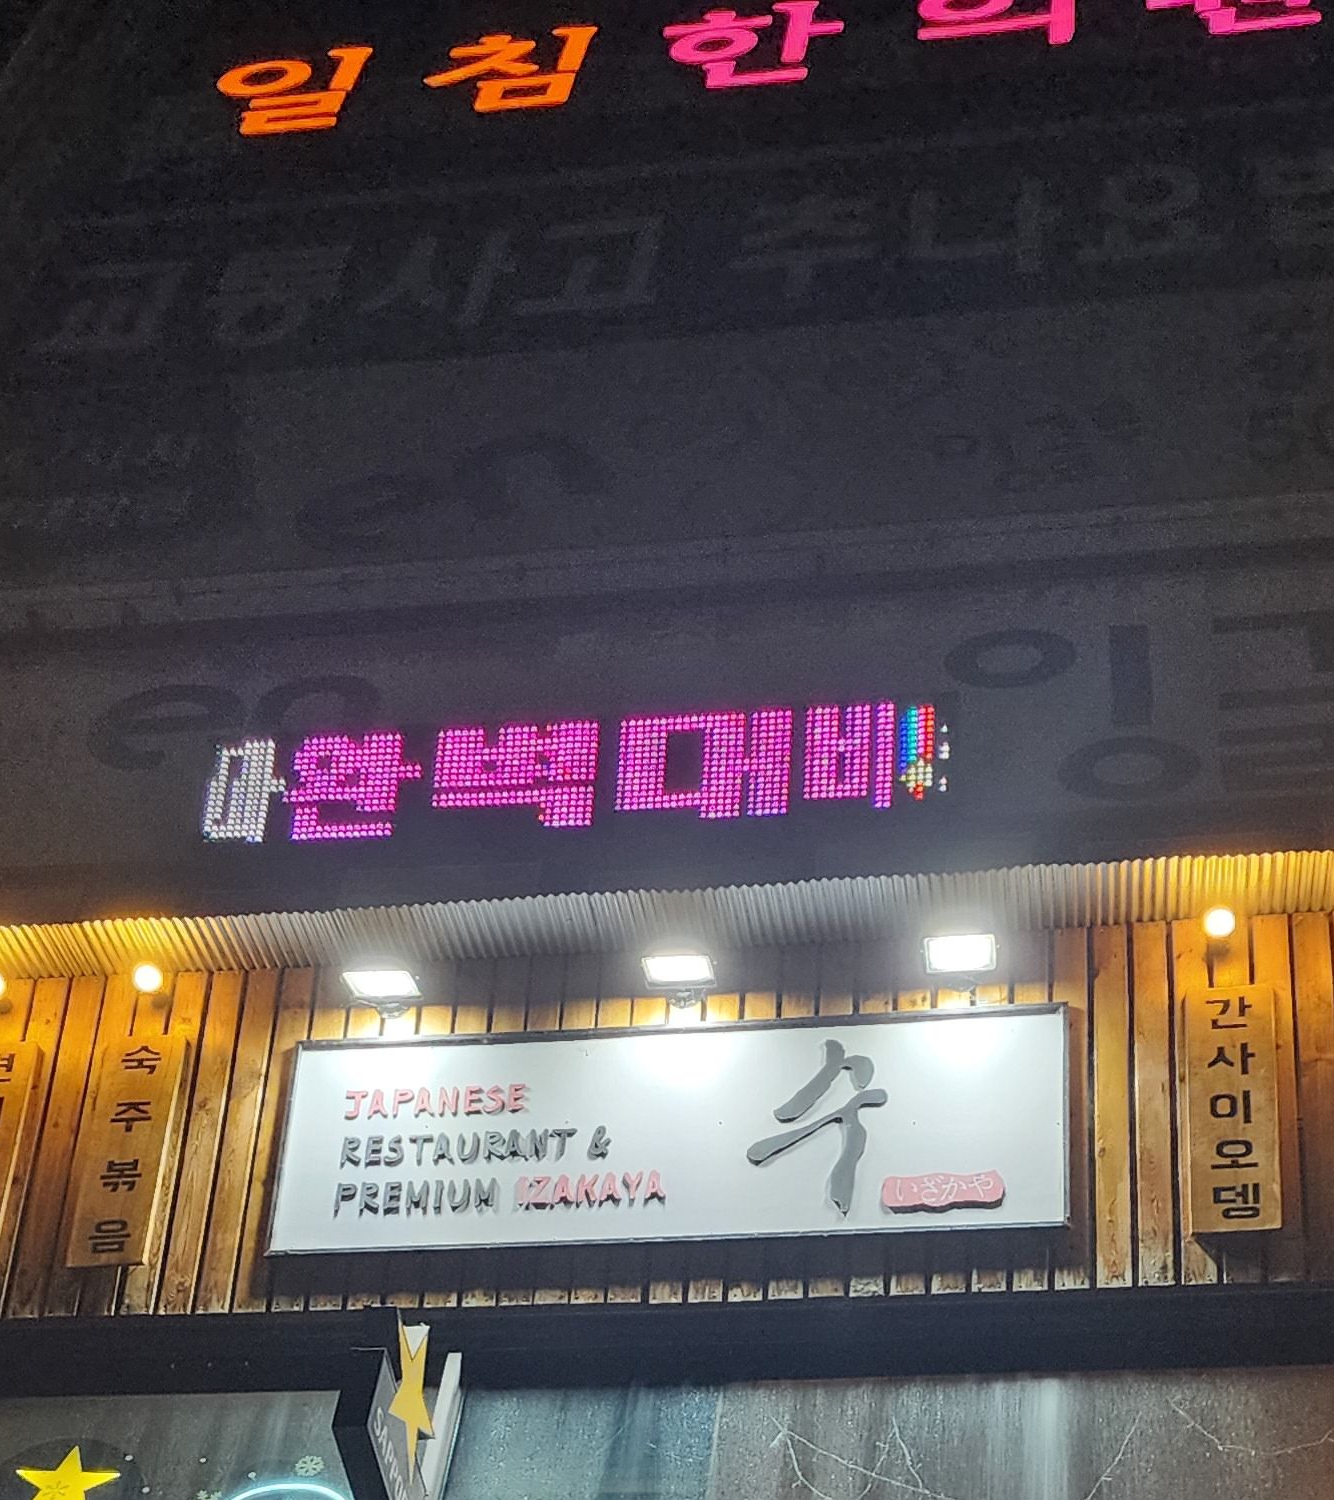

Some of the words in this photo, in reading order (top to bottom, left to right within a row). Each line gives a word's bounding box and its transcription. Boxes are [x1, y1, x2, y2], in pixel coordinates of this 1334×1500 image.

[34, 214, 665, 353] 교통사고
[344, 1082, 531, 1120] JAPANESE
[1205, 993, 1262, 1222] 간사이오뎅
[87, 1044, 164, 1254] 숙주볶음
[339, 1127, 579, 1168] RESTAURANT
[586, 1124, 612, 1160] &
[333, 1176, 499, 1218] PREMIUM
[513, 1170, 667, 1212] IZAKAYA
[895, 1173, 995, 1204] いざかや
